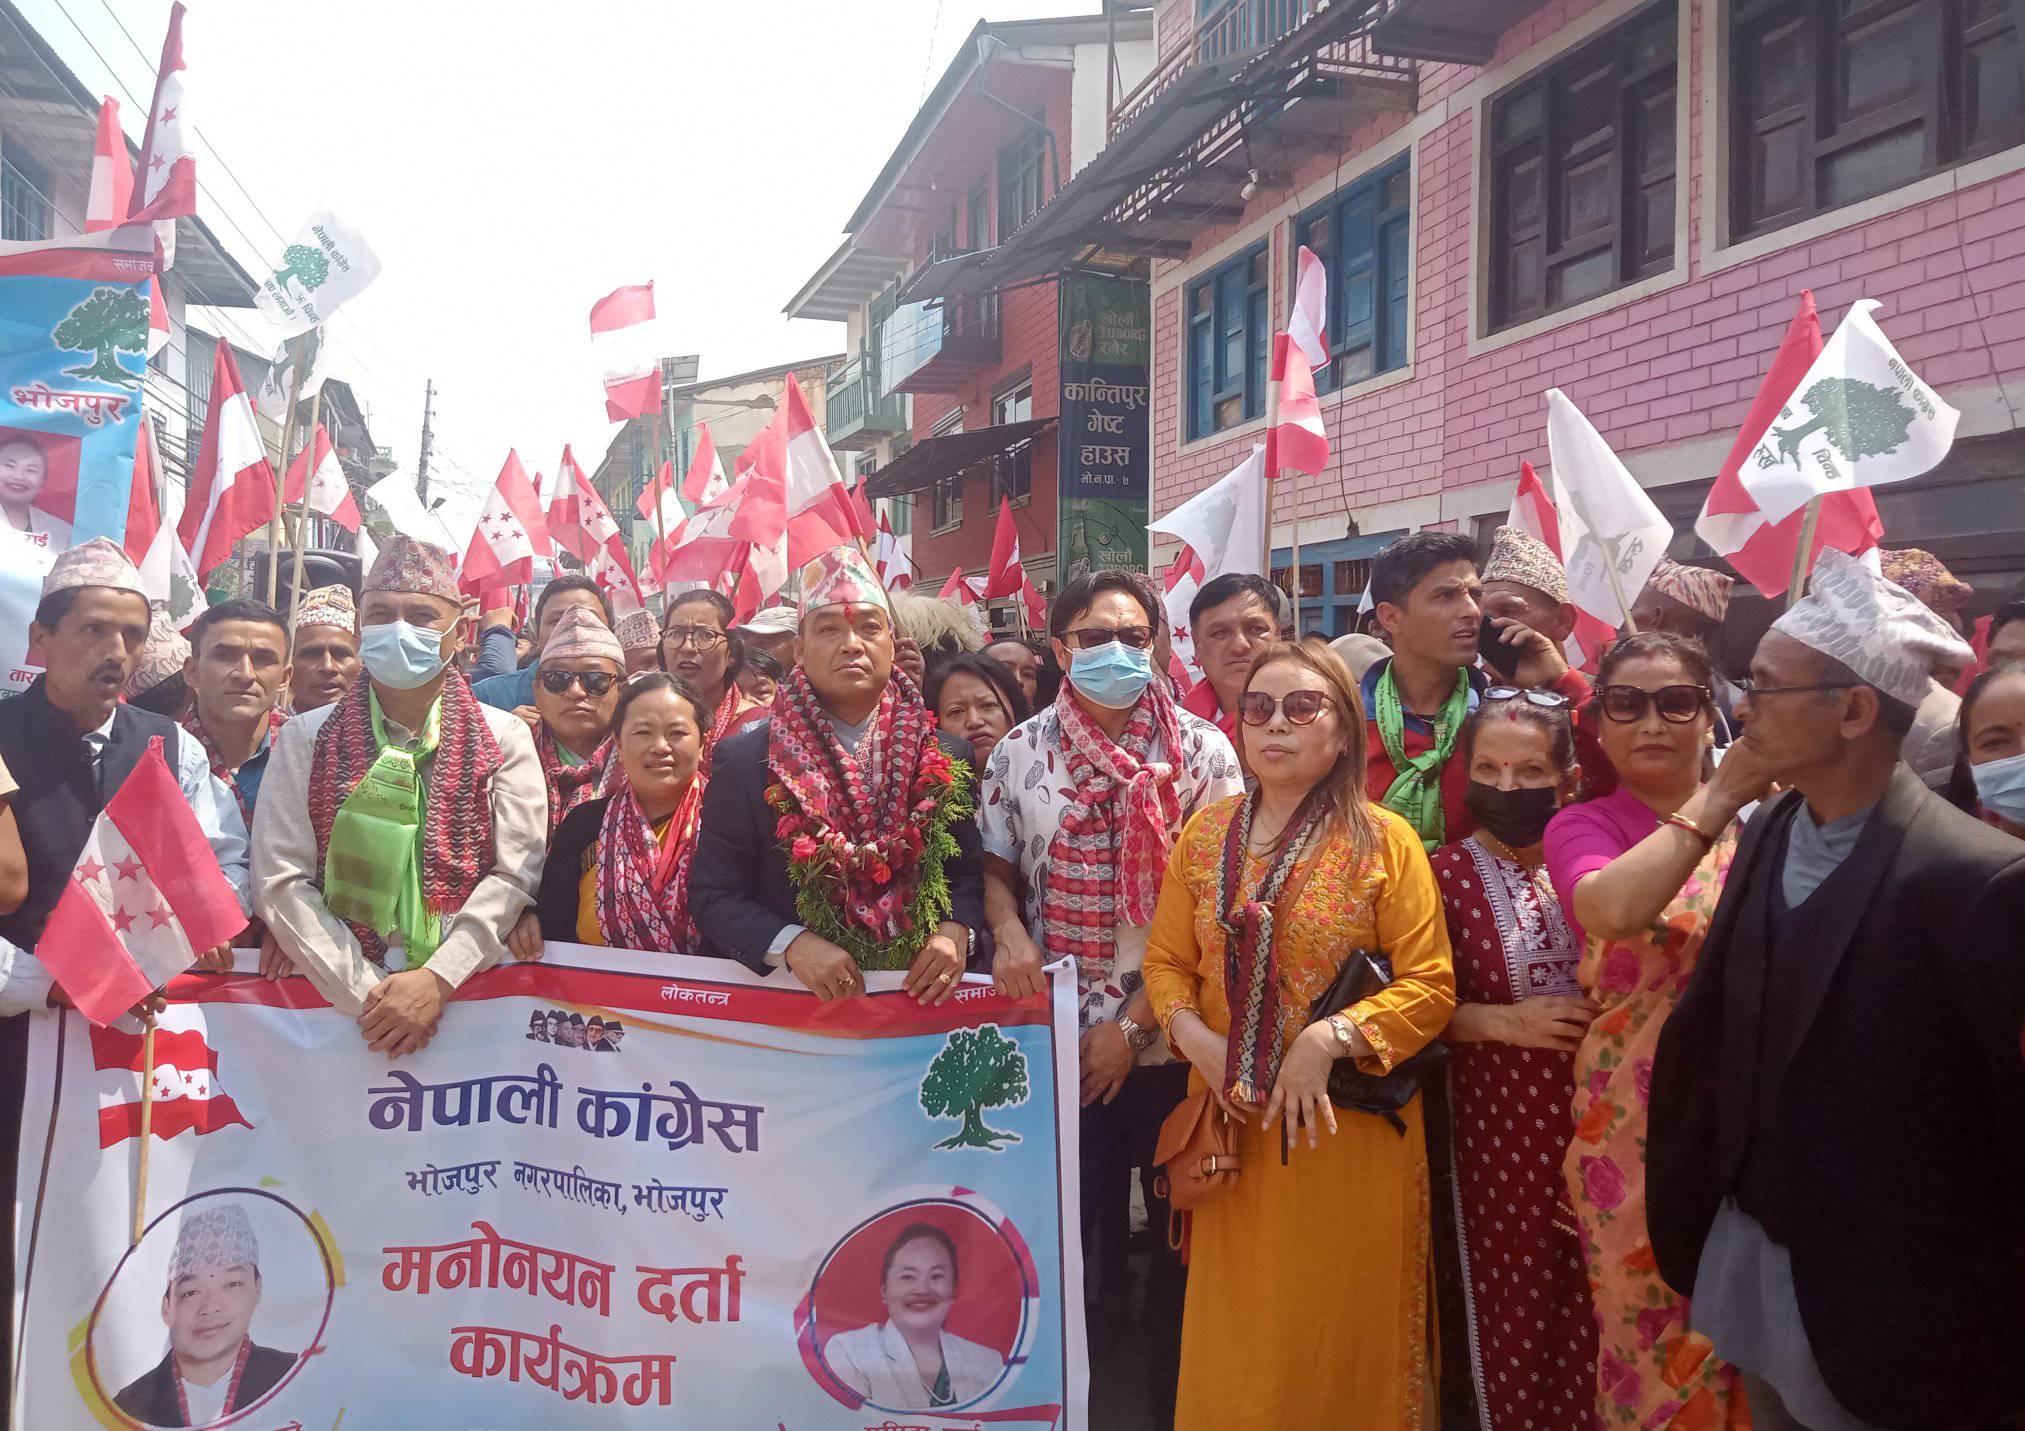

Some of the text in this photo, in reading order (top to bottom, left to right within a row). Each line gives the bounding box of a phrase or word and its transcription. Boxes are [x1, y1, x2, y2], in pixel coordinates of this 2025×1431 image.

[1100, 327, 1146, 341] TUBORG
[14, 383, 128, 425] भोजपुर
[1064, 377, 1149, 409] कान्तिपुर
[1087, 408, 1126, 434] गेष्ट
[1081, 445, 1132, 467] हाउस
[661, 984, 731, 1005] लोकतन्त्र
[368, 1063, 764, 1153] नेपाली कांग्रेस
[405, 1161, 728, 1222] भोजपुर नगरपालिका, भोजपुर
[382, 1221, 746, 1323] मनोनयन दर्ता
[450, 1324, 677, 1406] कार्यक्रम
